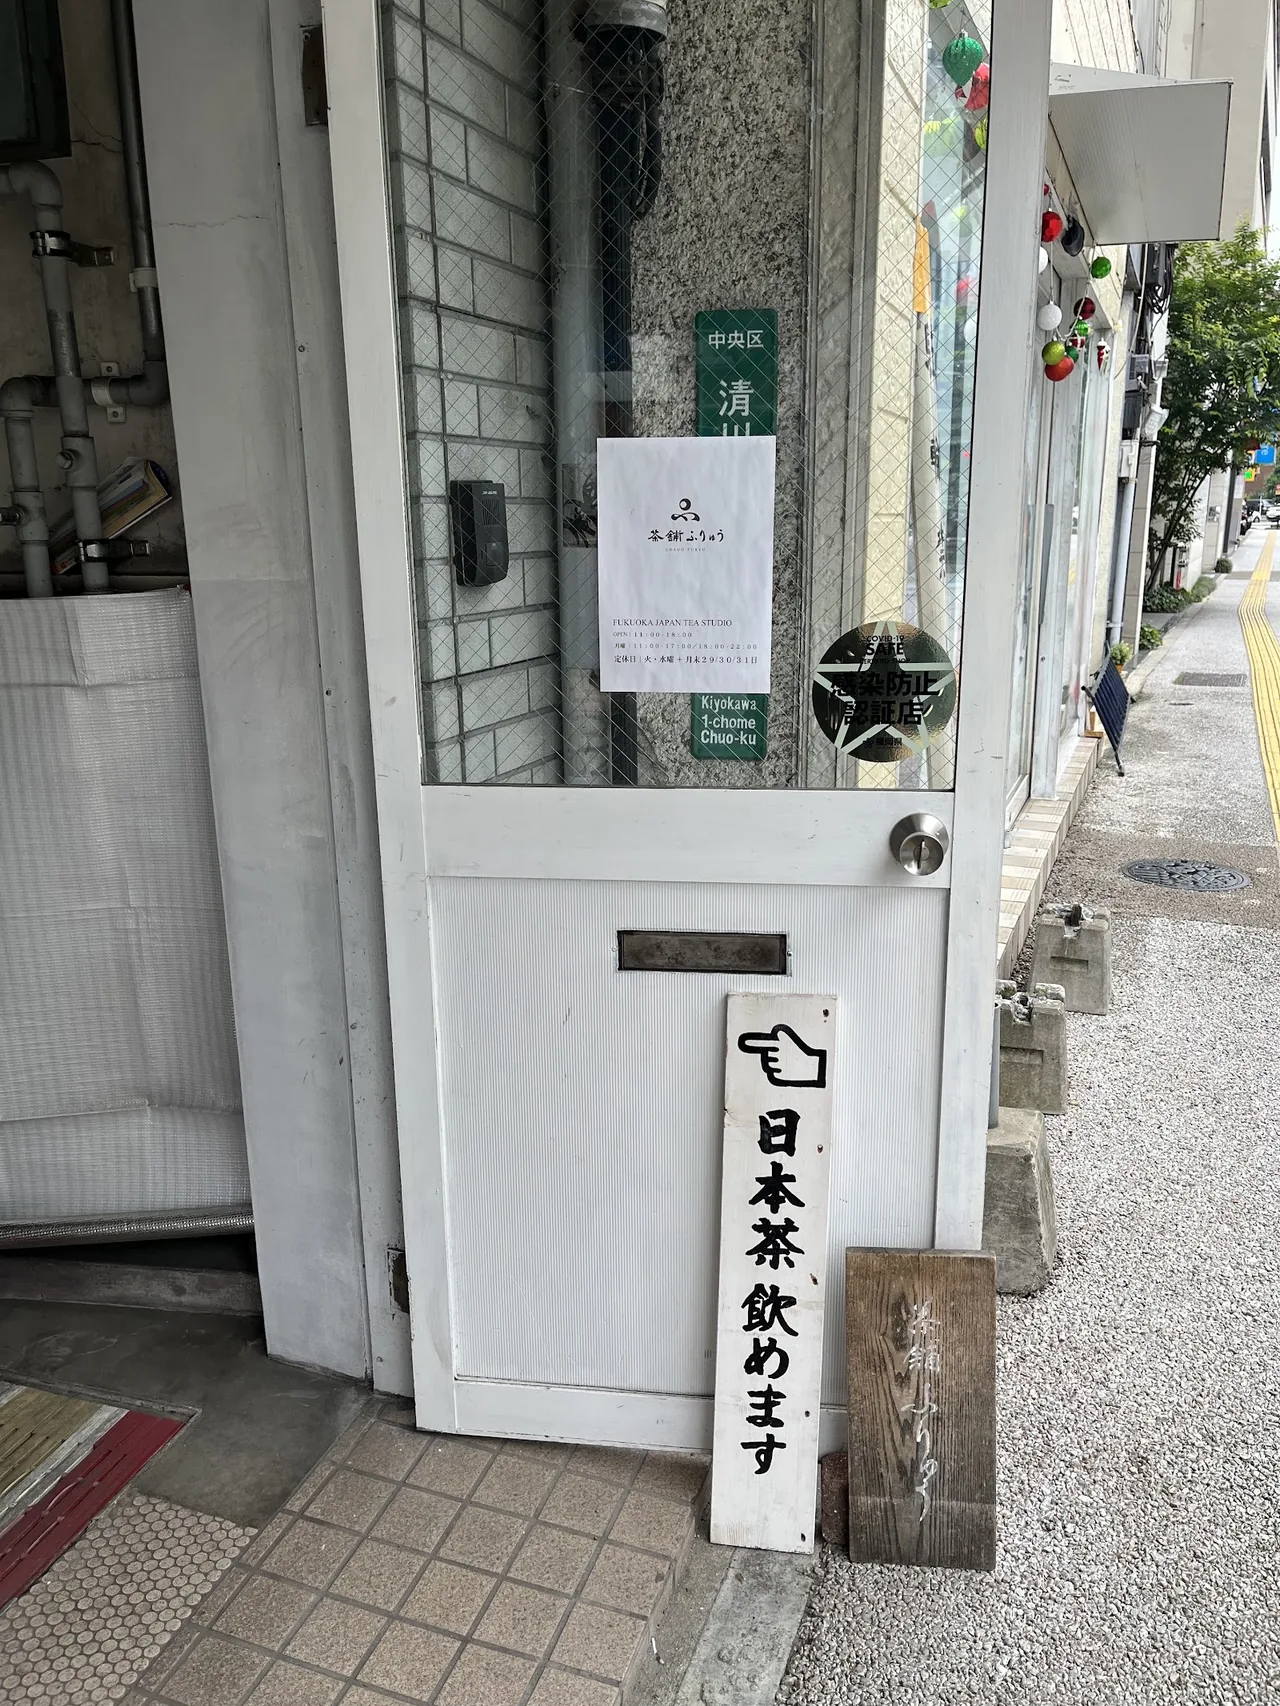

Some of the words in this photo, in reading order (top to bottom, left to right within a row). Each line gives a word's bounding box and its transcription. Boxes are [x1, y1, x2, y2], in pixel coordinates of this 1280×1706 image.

[708, 330, 764, 350] 中央区
[612, 619, 654, 627] FUKUOKA
[655, 619, 681, 627] JAPAN
[683, 619, 700, 627] TEA
[701, 619, 733, 627] STUDIO
[865, 642, 904, 655] SAFE
[831, 670, 940, 697] 感染防止
[701, 695, 757, 713] Kiyokawa
[844, 699, 924, 726] 認証店
[701, 714, 756, 729] 1-chome
[700, 729, 757, 745] Chuo-ku
[740, 1108, 807, 1476] 日本茶飲めます
